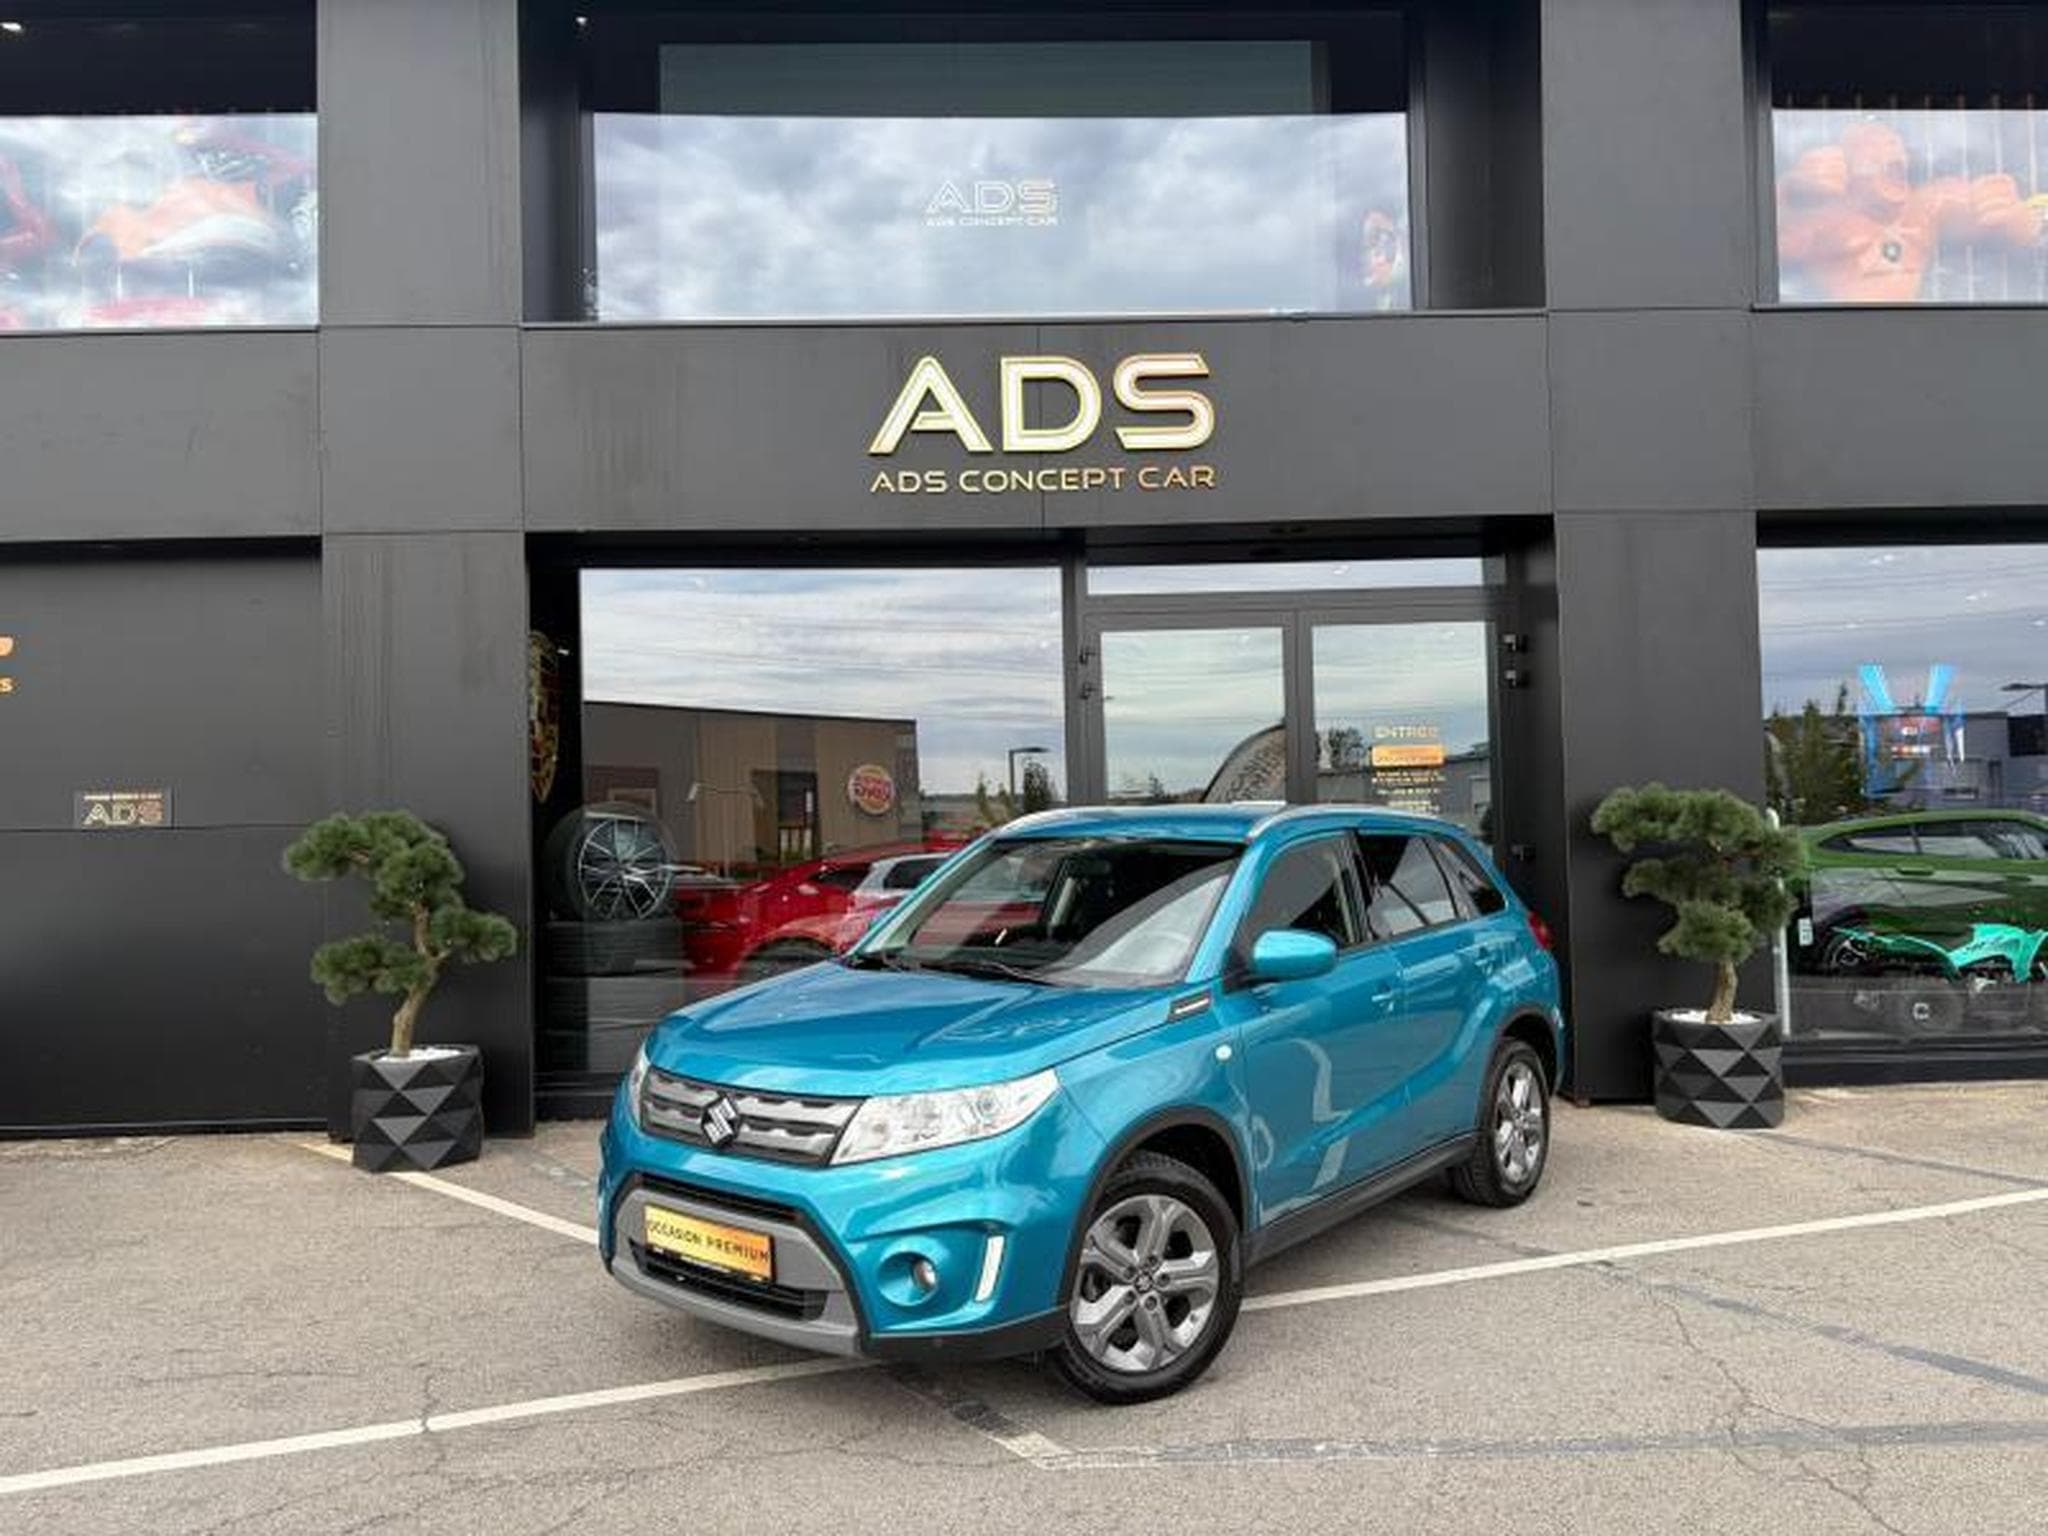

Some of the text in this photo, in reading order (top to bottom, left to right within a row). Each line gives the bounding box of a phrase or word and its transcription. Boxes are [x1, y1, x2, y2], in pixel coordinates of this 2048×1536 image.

[925, 180, 1058, 213] ADS
[868, 353, 1215, 455] ADS
[869, 465, 1216, 493] ADS CONCEPT CAR
[706, 1235, 769, 1263] PREMIUM
